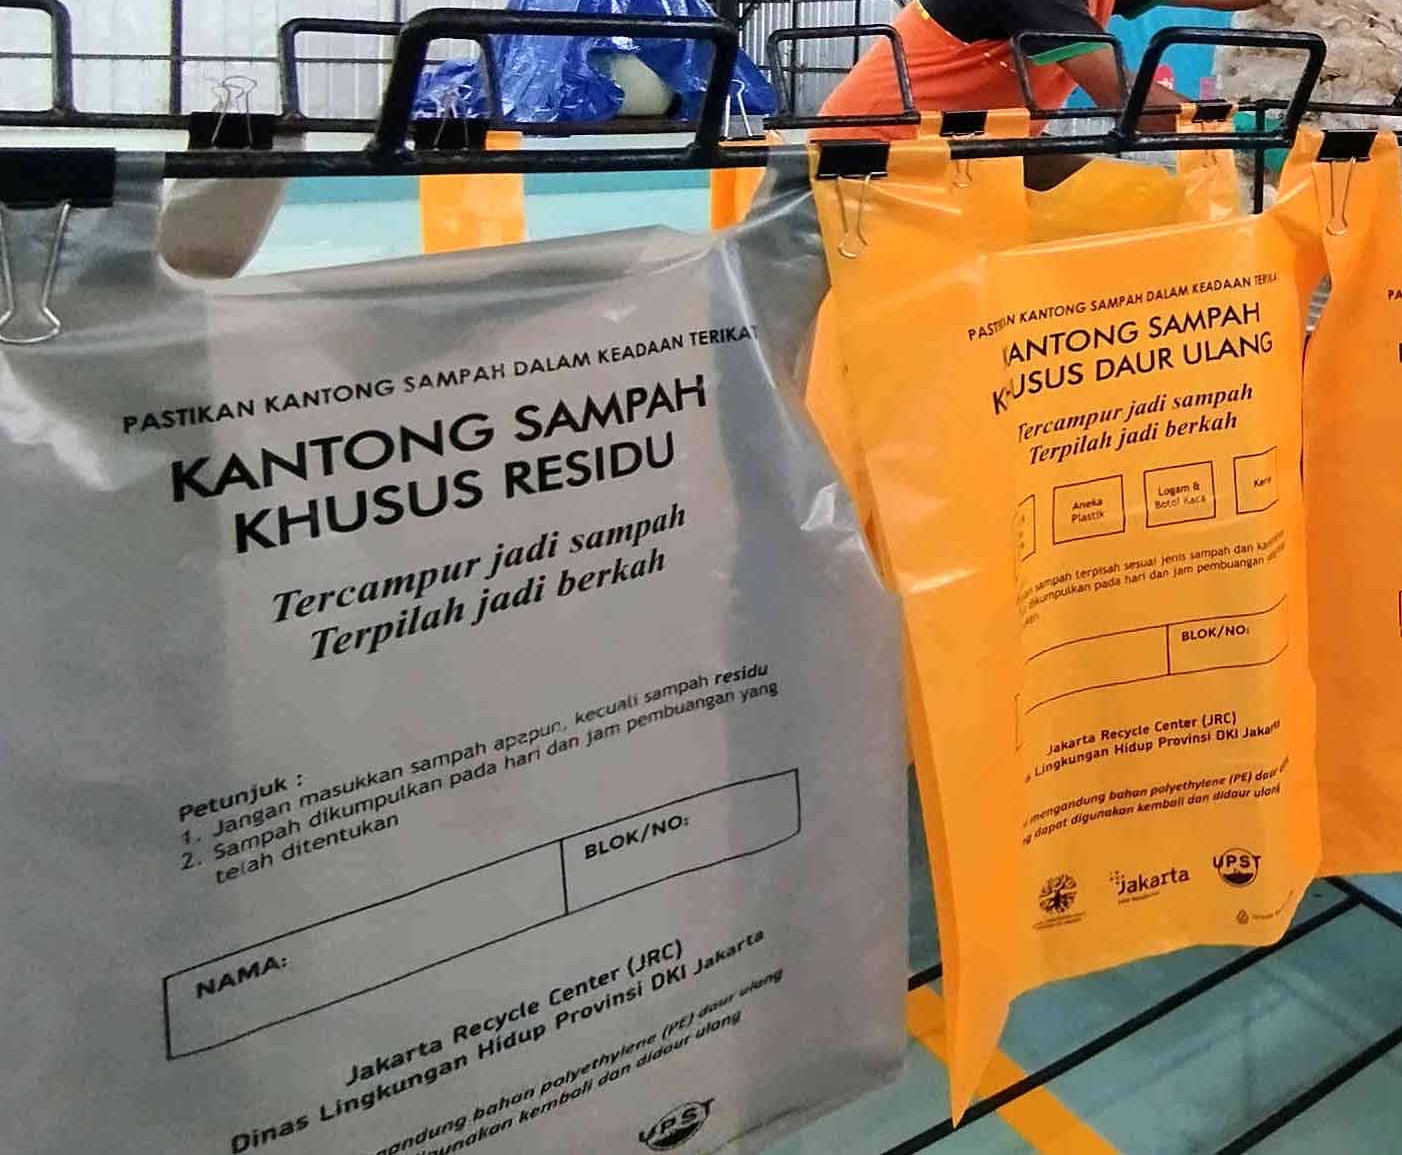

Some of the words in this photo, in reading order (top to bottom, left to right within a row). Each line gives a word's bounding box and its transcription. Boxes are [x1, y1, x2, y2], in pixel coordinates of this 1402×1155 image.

[1019, 301, 1086, 324] KANTONG
[1090, 292, 1143, 311] SAMPAH
[1146, 285, 1188, 302] DALAM
[1192, 276, 1251, 294] KEADAAN
[1149, 301, 1260, 339] SAMPAH
[123, 400, 255, 434] PASTIKAN
[265, 379, 395, 414] KANTONG
[403, 364, 505, 393] SAMPAH
[513, 351, 591, 377] DALAM
[598, 334, 684, 364] KEADAAN
[992, 361, 1084, 416] KUSUS
[1096, 347, 1174, 382] DAUR
[1183, 330, 1273, 365] ULANG
[171, 412, 495, 502] KANTONG
[514, 374, 707, 443] SAMPAH
[1018, 405, 1122, 444] Tercampur
[1125, 393, 1167, 422] jadi
[1173, 382, 1253, 408] sampah
[1029, 431, 1112, 465] Terpilah
[1115, 421, 1159, 451] jadi
[1165, 411, 1238, 438] berkah
[234, 470, 484, 554] KHUSUS
[504, 431, 675, 499] RESIDU
[1071, 510, 1104, 524] Plastik
[1072, 498, 1103, 510] Aneka
[1158, 485, 1190, 497] Logam
[272, 556, 482, 623] Tercampur
[486, 530, 559, 580] jadi
[569, 502, 686, 554] sampah
[1075, 562, 1120, 580] terpisah
[1124, 556, 1157, 570] sesuai
[1161, 550, 1186, 566] jenis
[1190, 544, 1230, 561] sampah
[1233, 541, 1254, 555] dan
[1094, 575, 1121, 592] pada
[1125, 571, 1146, 585] hari
[1150, 568, 1169, 580] dan
[1173, 565, 1194, 579] jam
[1197, 555, 1264, 574] pembuangan
[309, 595, 465, 661] Terpilah
[471, 574, 546, 626] jadi
[556, 547, 666, 598] berkah
[213, 800, 291, 839] Jangan
[299, 764, 404, 809] masukkan
[410, 739, 488, 774] sampah
[575, 691, 639, 725] kecuali
[643, 673, 709, 704] sampah
[714, 661, 769, 686] residu
[1034, 746, 1109, 778] Lingkungan
[1114, 739, 1153, 756] Hidup
[1158, 731, 1211, 748] Provinsi
[1216, 727, 1239, 741] DKI
[1046, 733, 1096, 756] Jakarta
[1101, 724, 1150, 741] Recycle
[1154, 717, 1197, 732] Center
[1202, 710, 1237, 729] (JRC)
[178, 776, 288, 822] Petunjuk
[180, 851, 203, 871] 2.
[213, 817, 301, 861] Sampah
[308, 774, 443, 830] dikumpulkan
[449, 759, 498, 788] pada
[503, 745, 541, 771] hari
[546, 732, 579, 758] dan
[585, 720, 621, 748] jam
[626, 688, 736, 734] pembuangan
[740, 679, 779, 704] yang
[1030, 789, 1106, 825] mengandung
[1109, 785, 1147, 801] bahan
[1150, 777, 1226, 797] polyethylene
[1229, 770, 1253, 786] (PE)
[584, 813, 690, 861] BLOK/NO:
[1034, 817, 1068, 838] dapat
[1071, 805, 1134, 826] digunakan
[1137, 794, 1184, 813] kembali
[1187, 791, 1209, 805] dan
[1212, 787, 1250, 801] didaur
[215, 851, 274, 885] telah
[281, 813, 400, 862] ditentukan
[1211, 853, 1262, 870] UPST
[195, 955, 289, 999] NAMA:
[344, 1037, 443, 1087] Jakarta
[452, 1000, 540, 1044] Recycle
[548, 965, 620, 1007] Center
[626, 937, 683, 979] (JRC)
[229, 1111, 310, 1155] Dinas
[318, 1053, 469, 1123] Lingkungan
[476, 1023, 547, 1060] Hidup
[554, 980, 644, 1030] Provinsi
[650, 963, 687, 992] DKI
[693, 928, 765, 976] Jakarta
[472, 1087, 535, 1122] bahan
[540, 1031, 657, 1097] polyethylene
[661, 1011, 695, 1040] (PE)
[698, 993, 735, 1019] daur
[739, 967, 784, 998] ulang
[518, 1077, 593, 1125] kembali
[597, 1062, 631, 1087] dan
[636, 1034, 691, 1069] didaur
[695, 1008, 742, 1041] ulang
[638, 1096, 716, 1144] UPST
